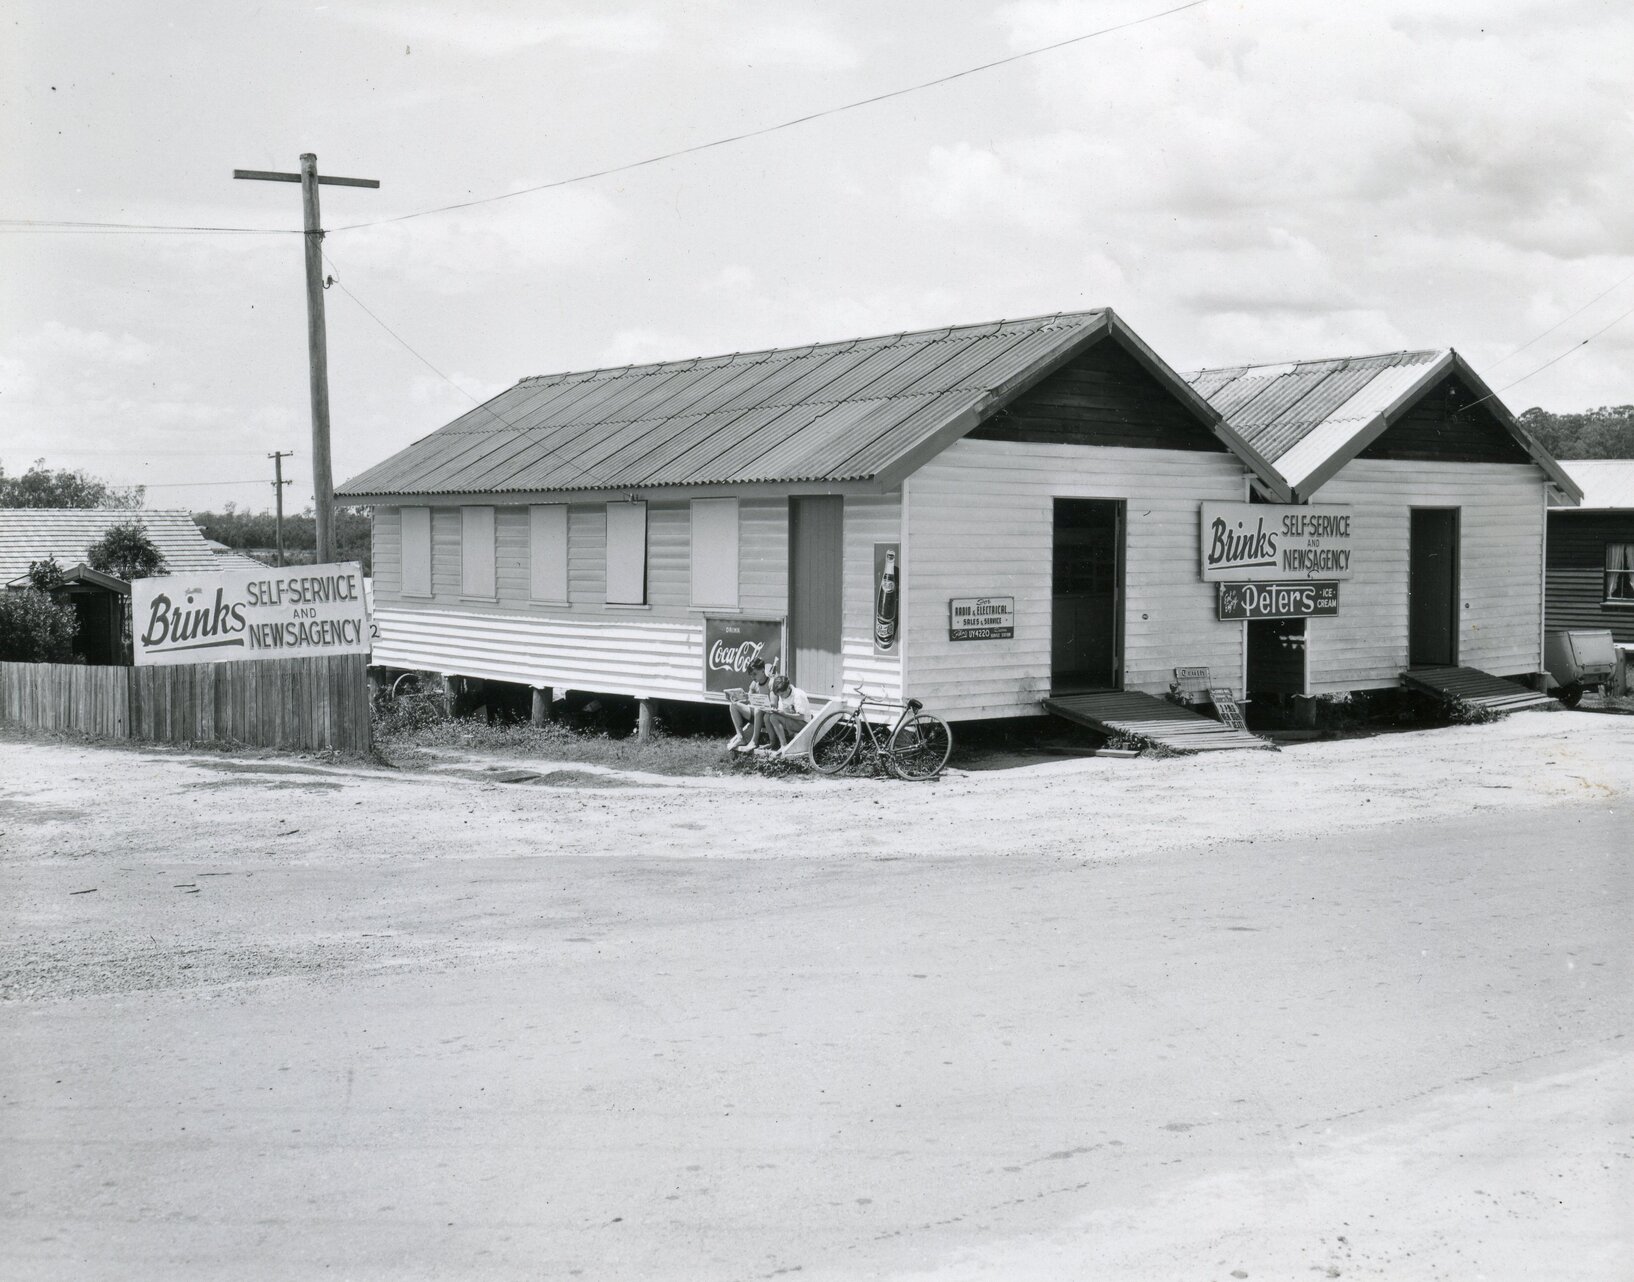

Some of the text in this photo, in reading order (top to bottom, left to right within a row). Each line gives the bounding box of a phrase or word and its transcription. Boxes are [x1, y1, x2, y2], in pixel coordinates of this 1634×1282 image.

[1281, 514, 1351, 537] SELF-SERVICE
[1208, 517, 1279, 565] Brinks
[1307, 539, 1320, 548] AND
[1283, 549, 1351, 572] NEWSAGENCY
[247, 575, 358, 607] SELF-SERVICE
[1322, 588, 1333, 598] ICE
[1240, 584, 1316, 617] Peters
[1317, 599, 1337, 608] CREAM
[141, 587, 247, 647] Brinks
[293, 607, 317, 619] AND
[955, 606, 971, 616] RADIO
[963, 618, 980, 626] SALES
[984, 617, 1002, 625] SERVICE
[249, 619, 362, 649] NEWSAGENCY
[369, 624, 380, 638] 2
[968, 629, 990, 638] UY4220
[709, 639, 765, 672] Coca-Col
